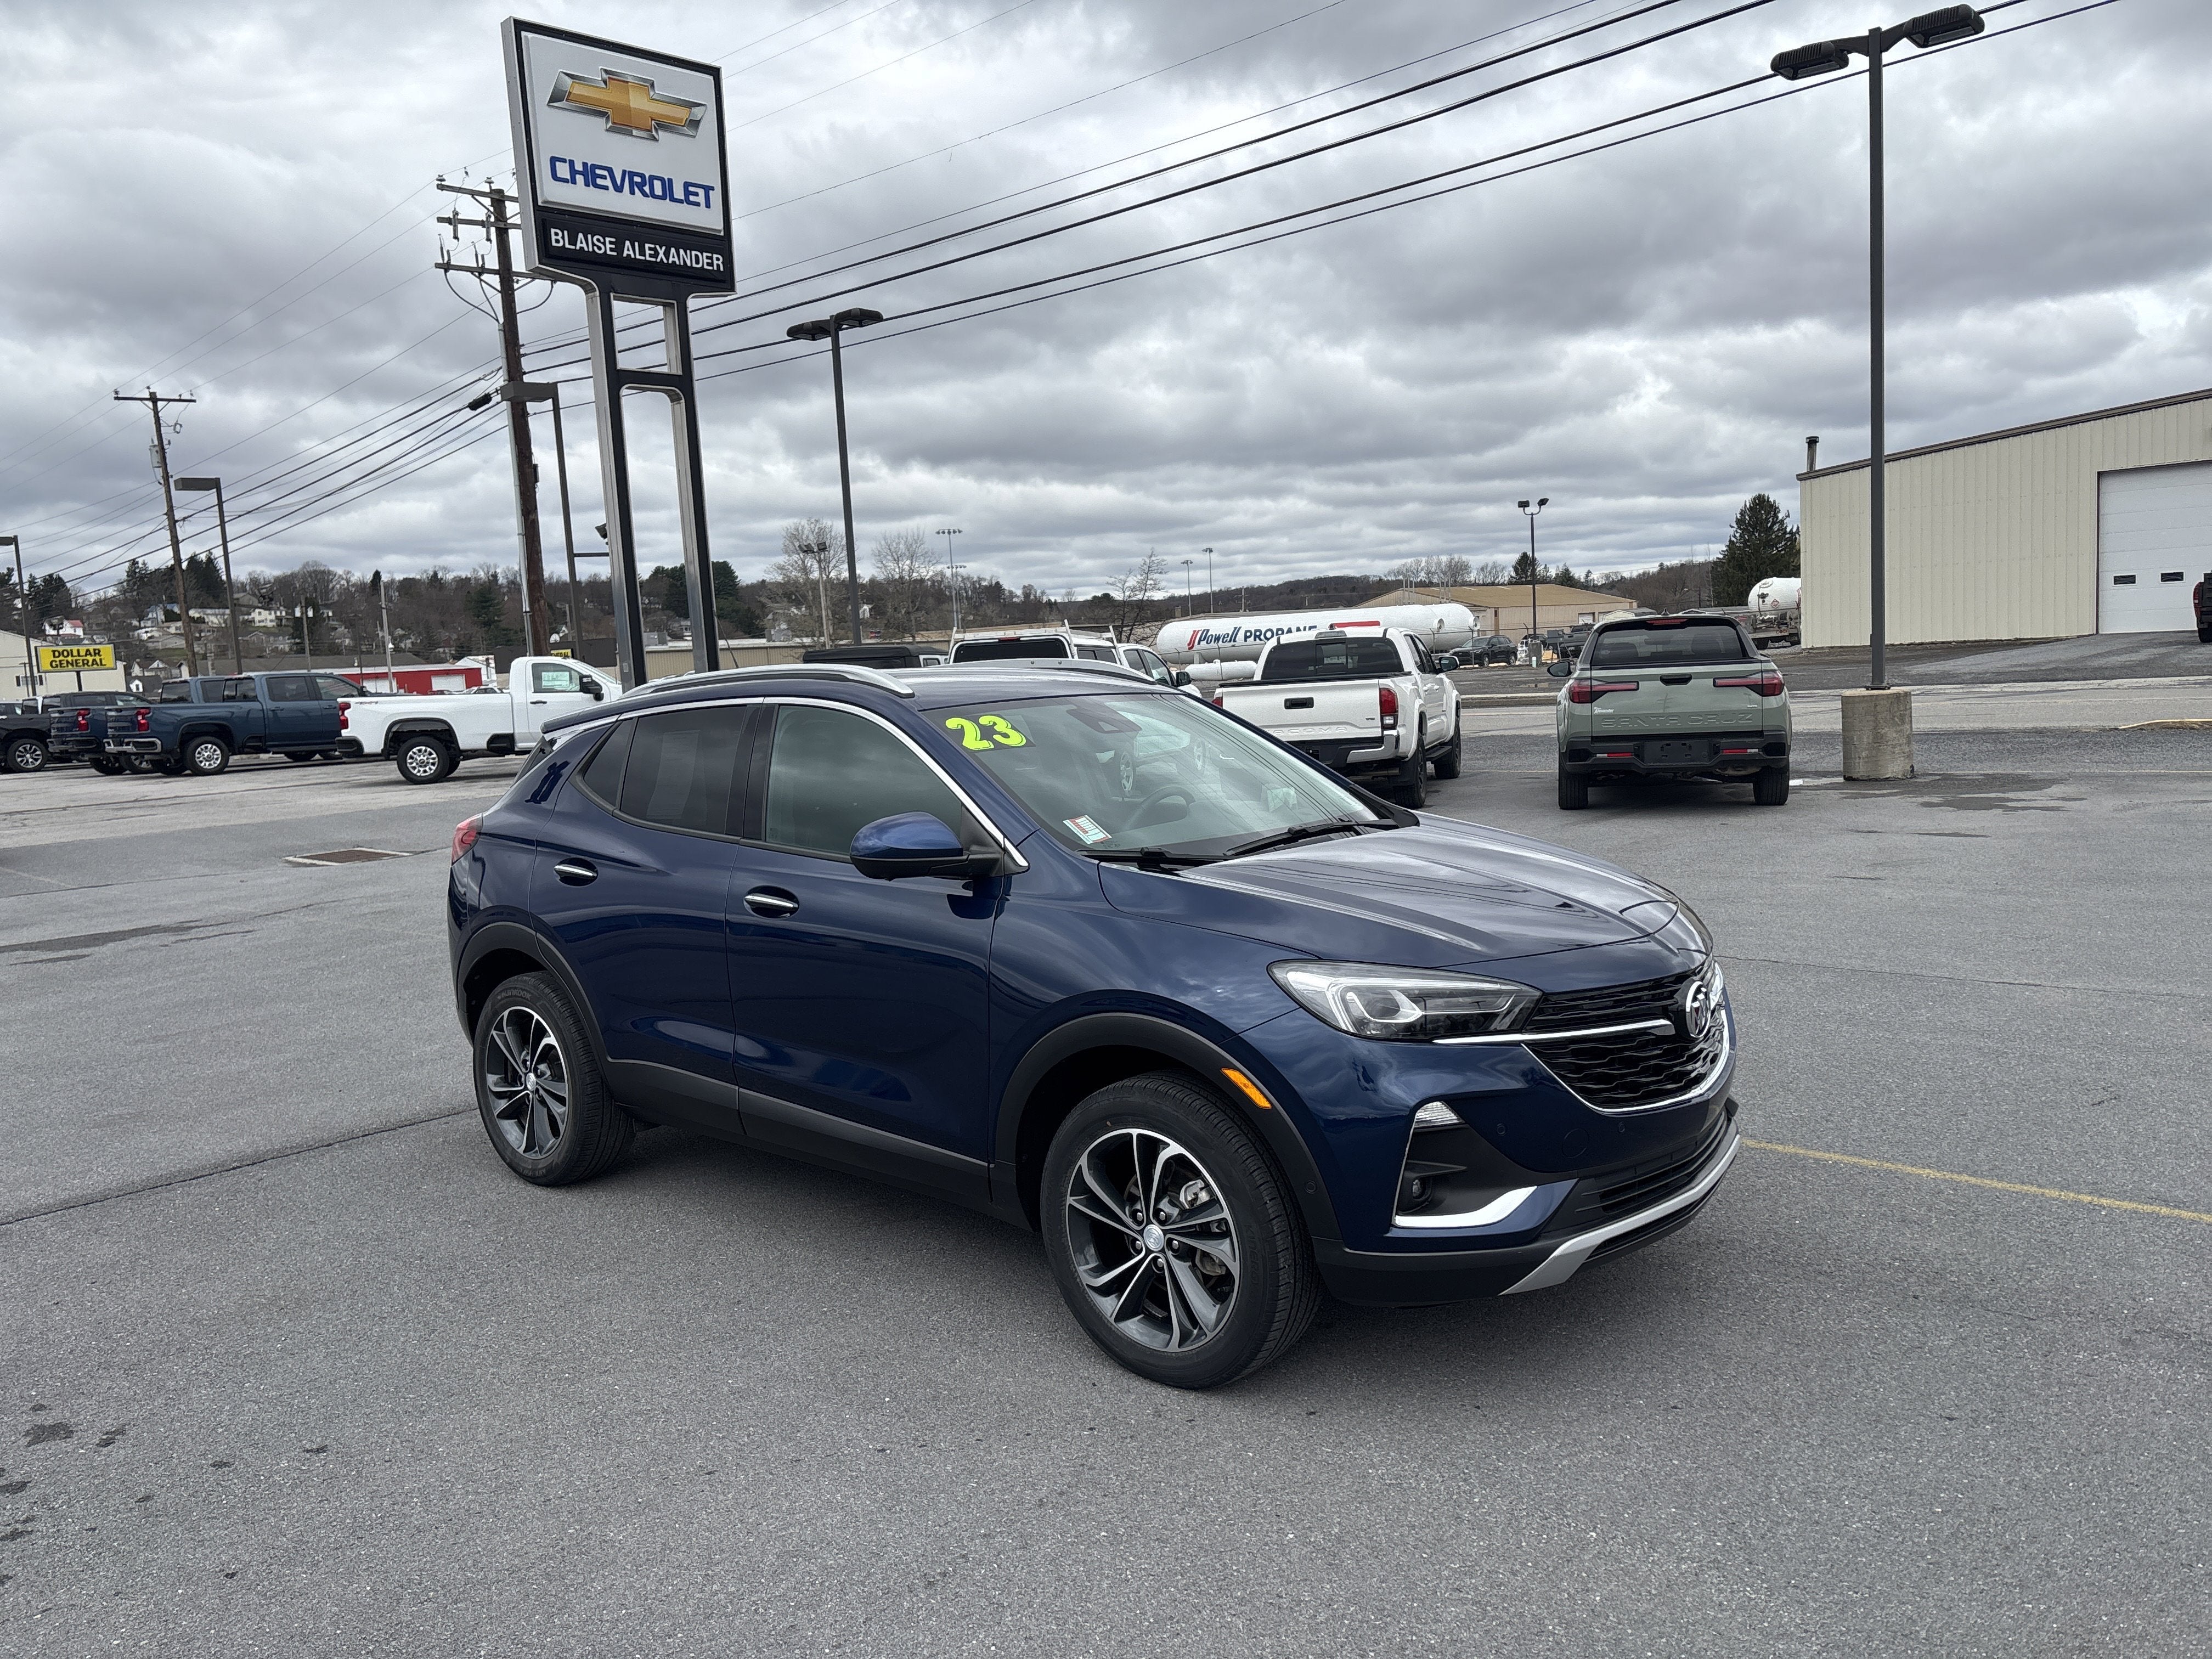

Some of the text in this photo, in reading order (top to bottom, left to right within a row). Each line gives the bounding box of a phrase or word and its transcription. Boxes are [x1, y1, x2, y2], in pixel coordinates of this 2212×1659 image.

[549, 155, 715, 208] CHEVROLET
[550, 228, 724, 272] BLAISE ALEXANDER
[1197, 626, 1242, 646] Powell
[51, 648, 102, 659] DOLLAR
[49, 658, 107, 668] GENERAL
[1601, 712, 1753, 727] SANTA CRUZ
[945, 715, 1026, 751] 23
[1267, 726, 1348, 736] ACOMA
